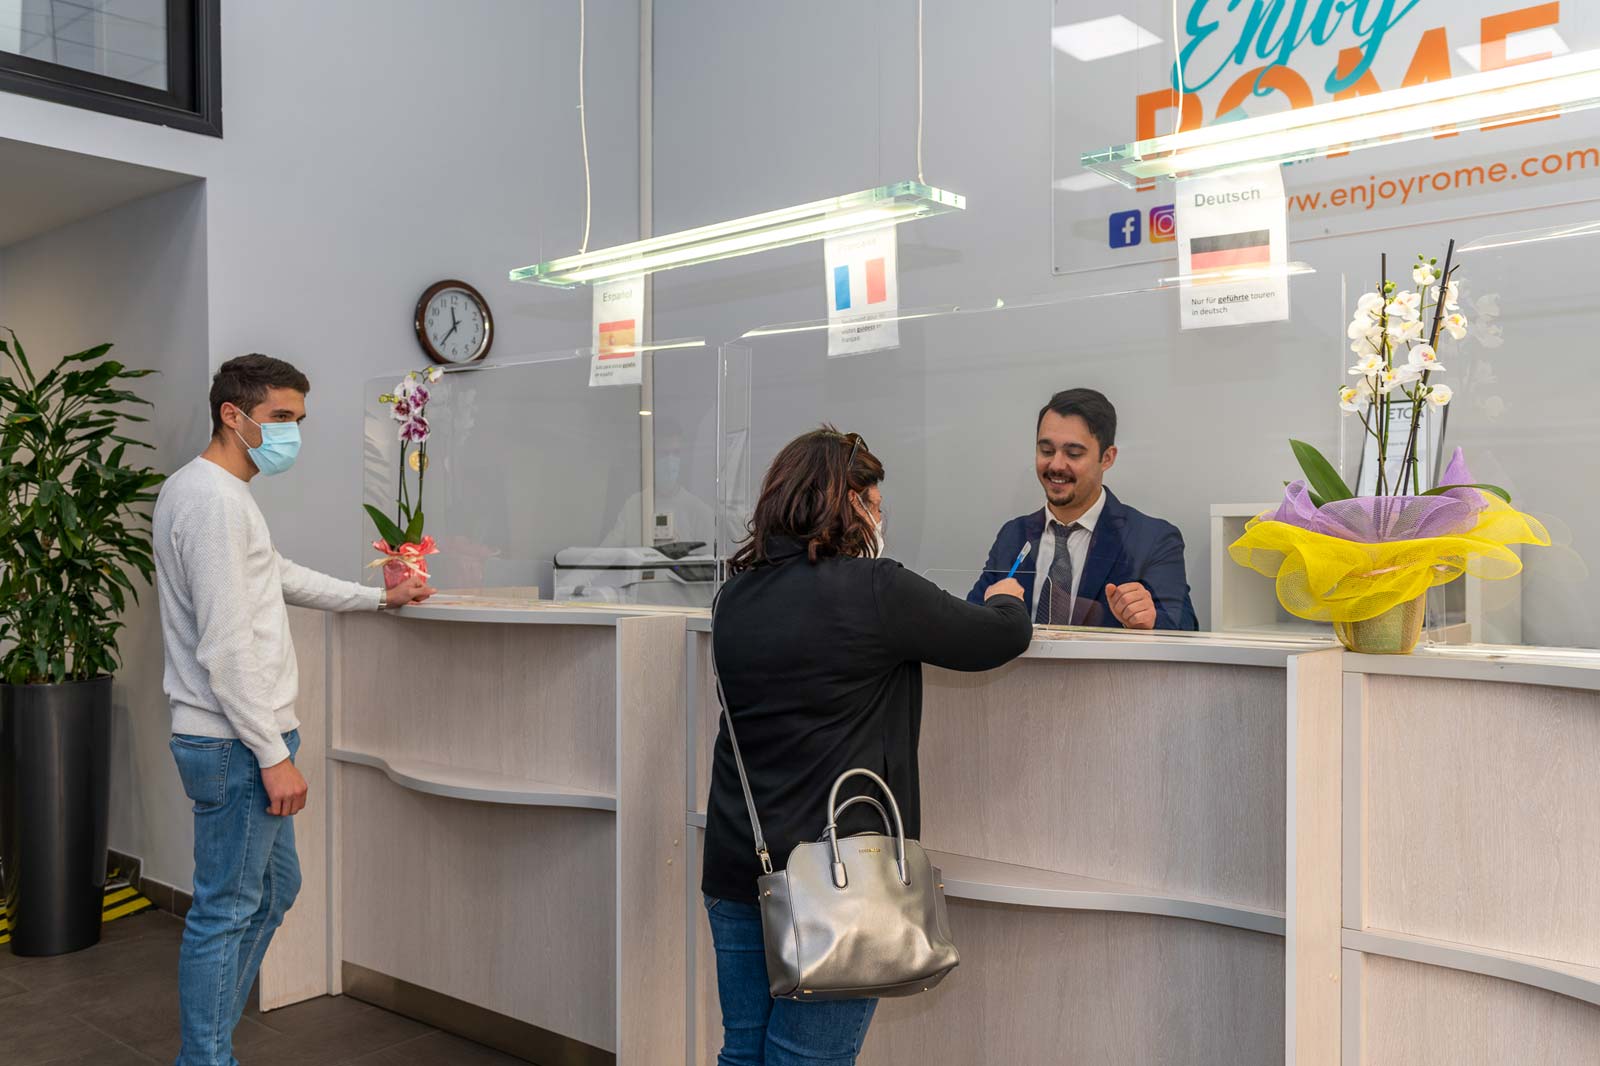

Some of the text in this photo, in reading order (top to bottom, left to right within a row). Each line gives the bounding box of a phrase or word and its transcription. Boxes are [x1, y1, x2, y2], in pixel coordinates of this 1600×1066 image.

[1288, 148, 1600, 212] w.enjoyrome.com
[1194, 188, 1261, 208] Deutsch
[450, 296, 458, 305] 12
[1191, 290, 1276, 306] Nur für geführte touren
[432, 307, 440, 316] 10
[1191, 306, 1228, 316] in deutsch
